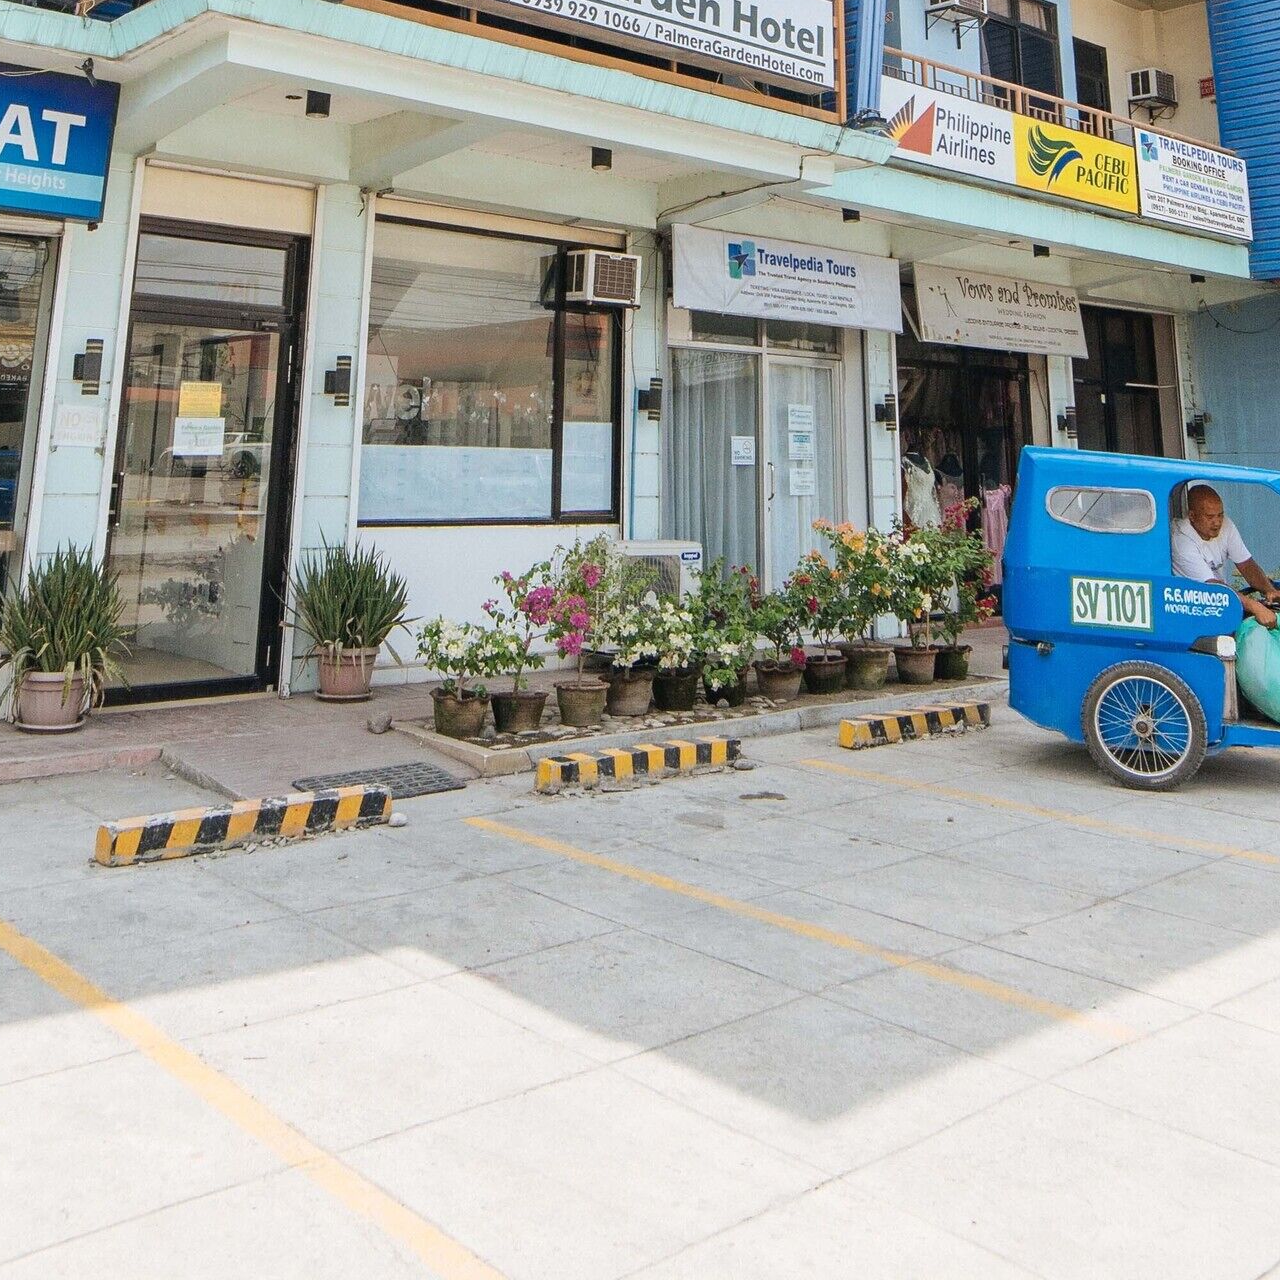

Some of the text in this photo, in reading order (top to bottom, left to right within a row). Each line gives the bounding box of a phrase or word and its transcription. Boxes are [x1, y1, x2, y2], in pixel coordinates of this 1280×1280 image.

[568, 0, 598, 22] 929
[604, 9, 641, 34] 1066
[655, 23, 824, 84] PalmeraGardenHotel.com
[732, 0, 824, 57] Hotel
[935, 107, 1012, 145] Philippine
[936, 133, 996, 166] Airlines
[1094, 153, 1130, 177] CEBU
[1159, 136, 1244, 173] TRAVELPEDIA TOURS
[1172, 155, 1226, 179] BOOKING OFFICE
[5, 166, 67, 193] Heights
[1076, 165, 1129, 195] PACIFIC
[757, 248, 857, 279] Travelpedia Tours
[956, 276, 1078, 313] Vows and Promises
[1075, 581, 1146, 624] SV 1101
